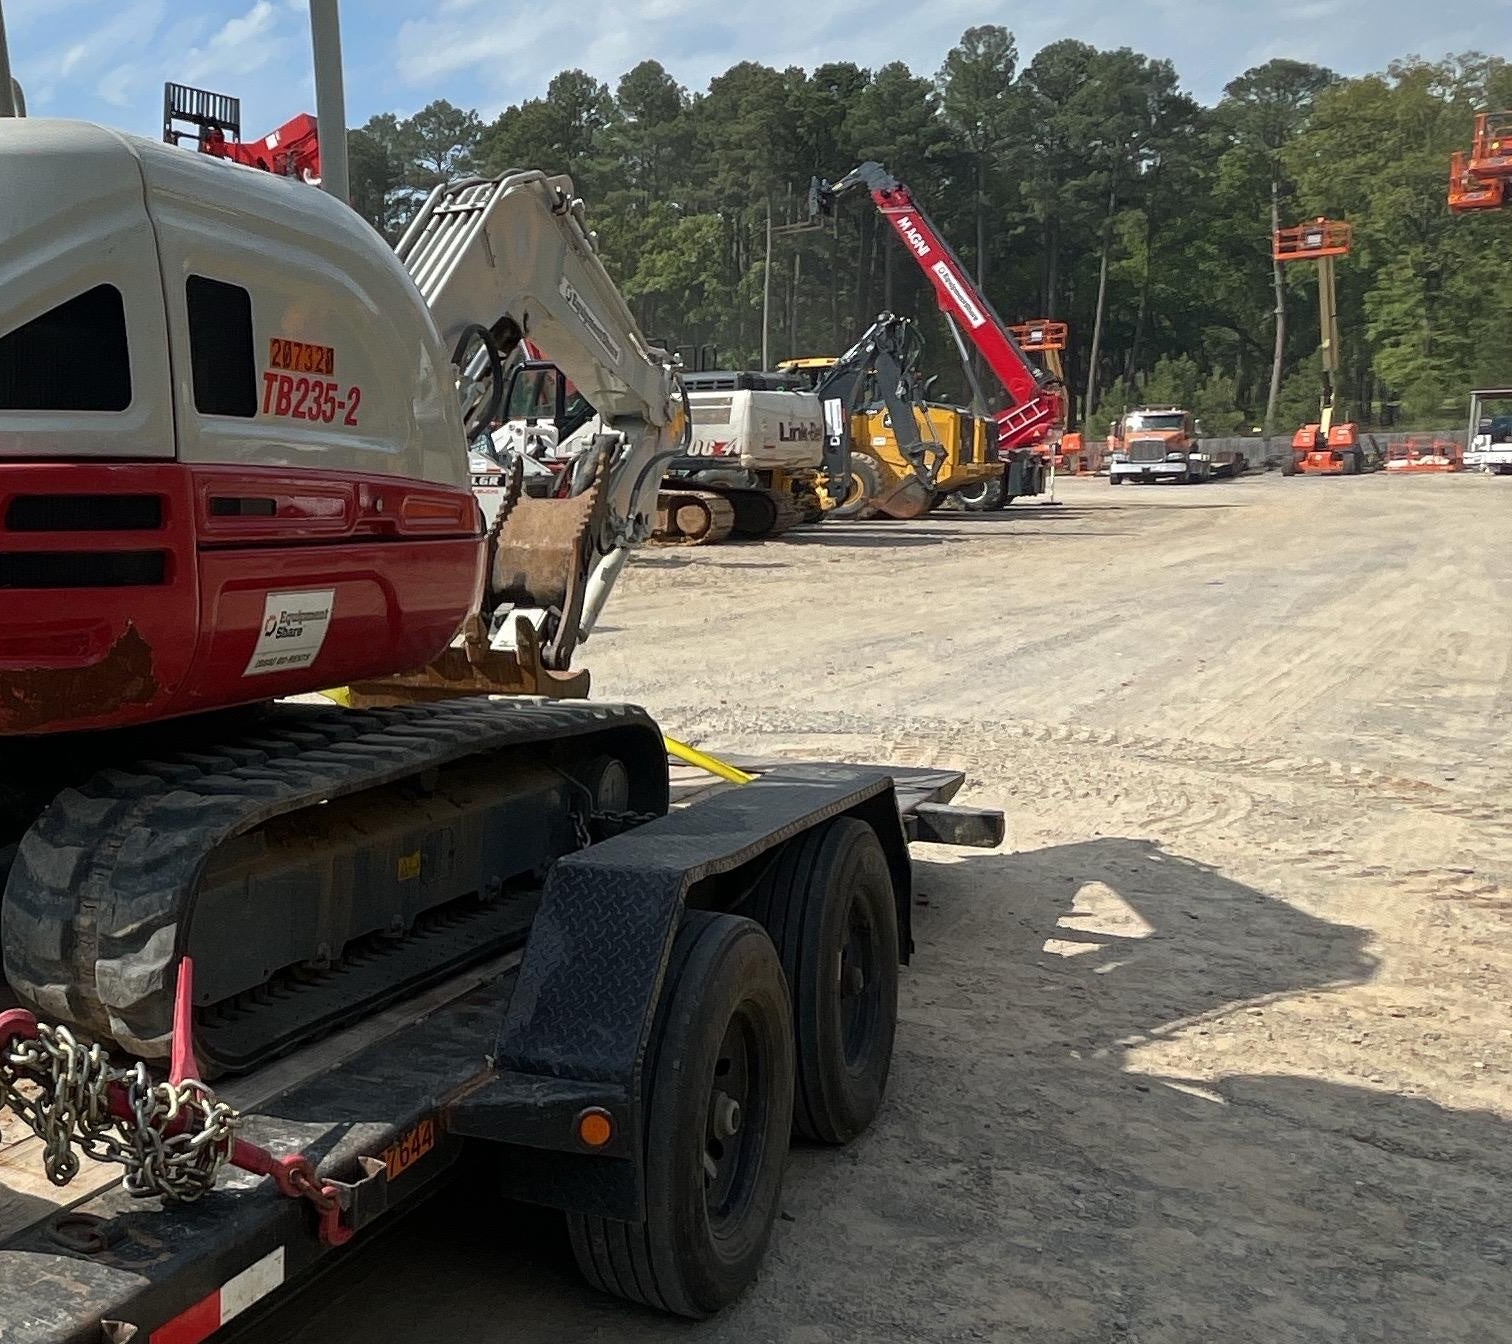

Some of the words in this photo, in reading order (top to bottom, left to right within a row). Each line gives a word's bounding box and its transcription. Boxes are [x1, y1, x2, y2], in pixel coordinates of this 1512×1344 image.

[897, 216, 931, 257] MAGNI
[263, 372, 361, 426] TB235-2
[275, 626, 304, 639] Share
